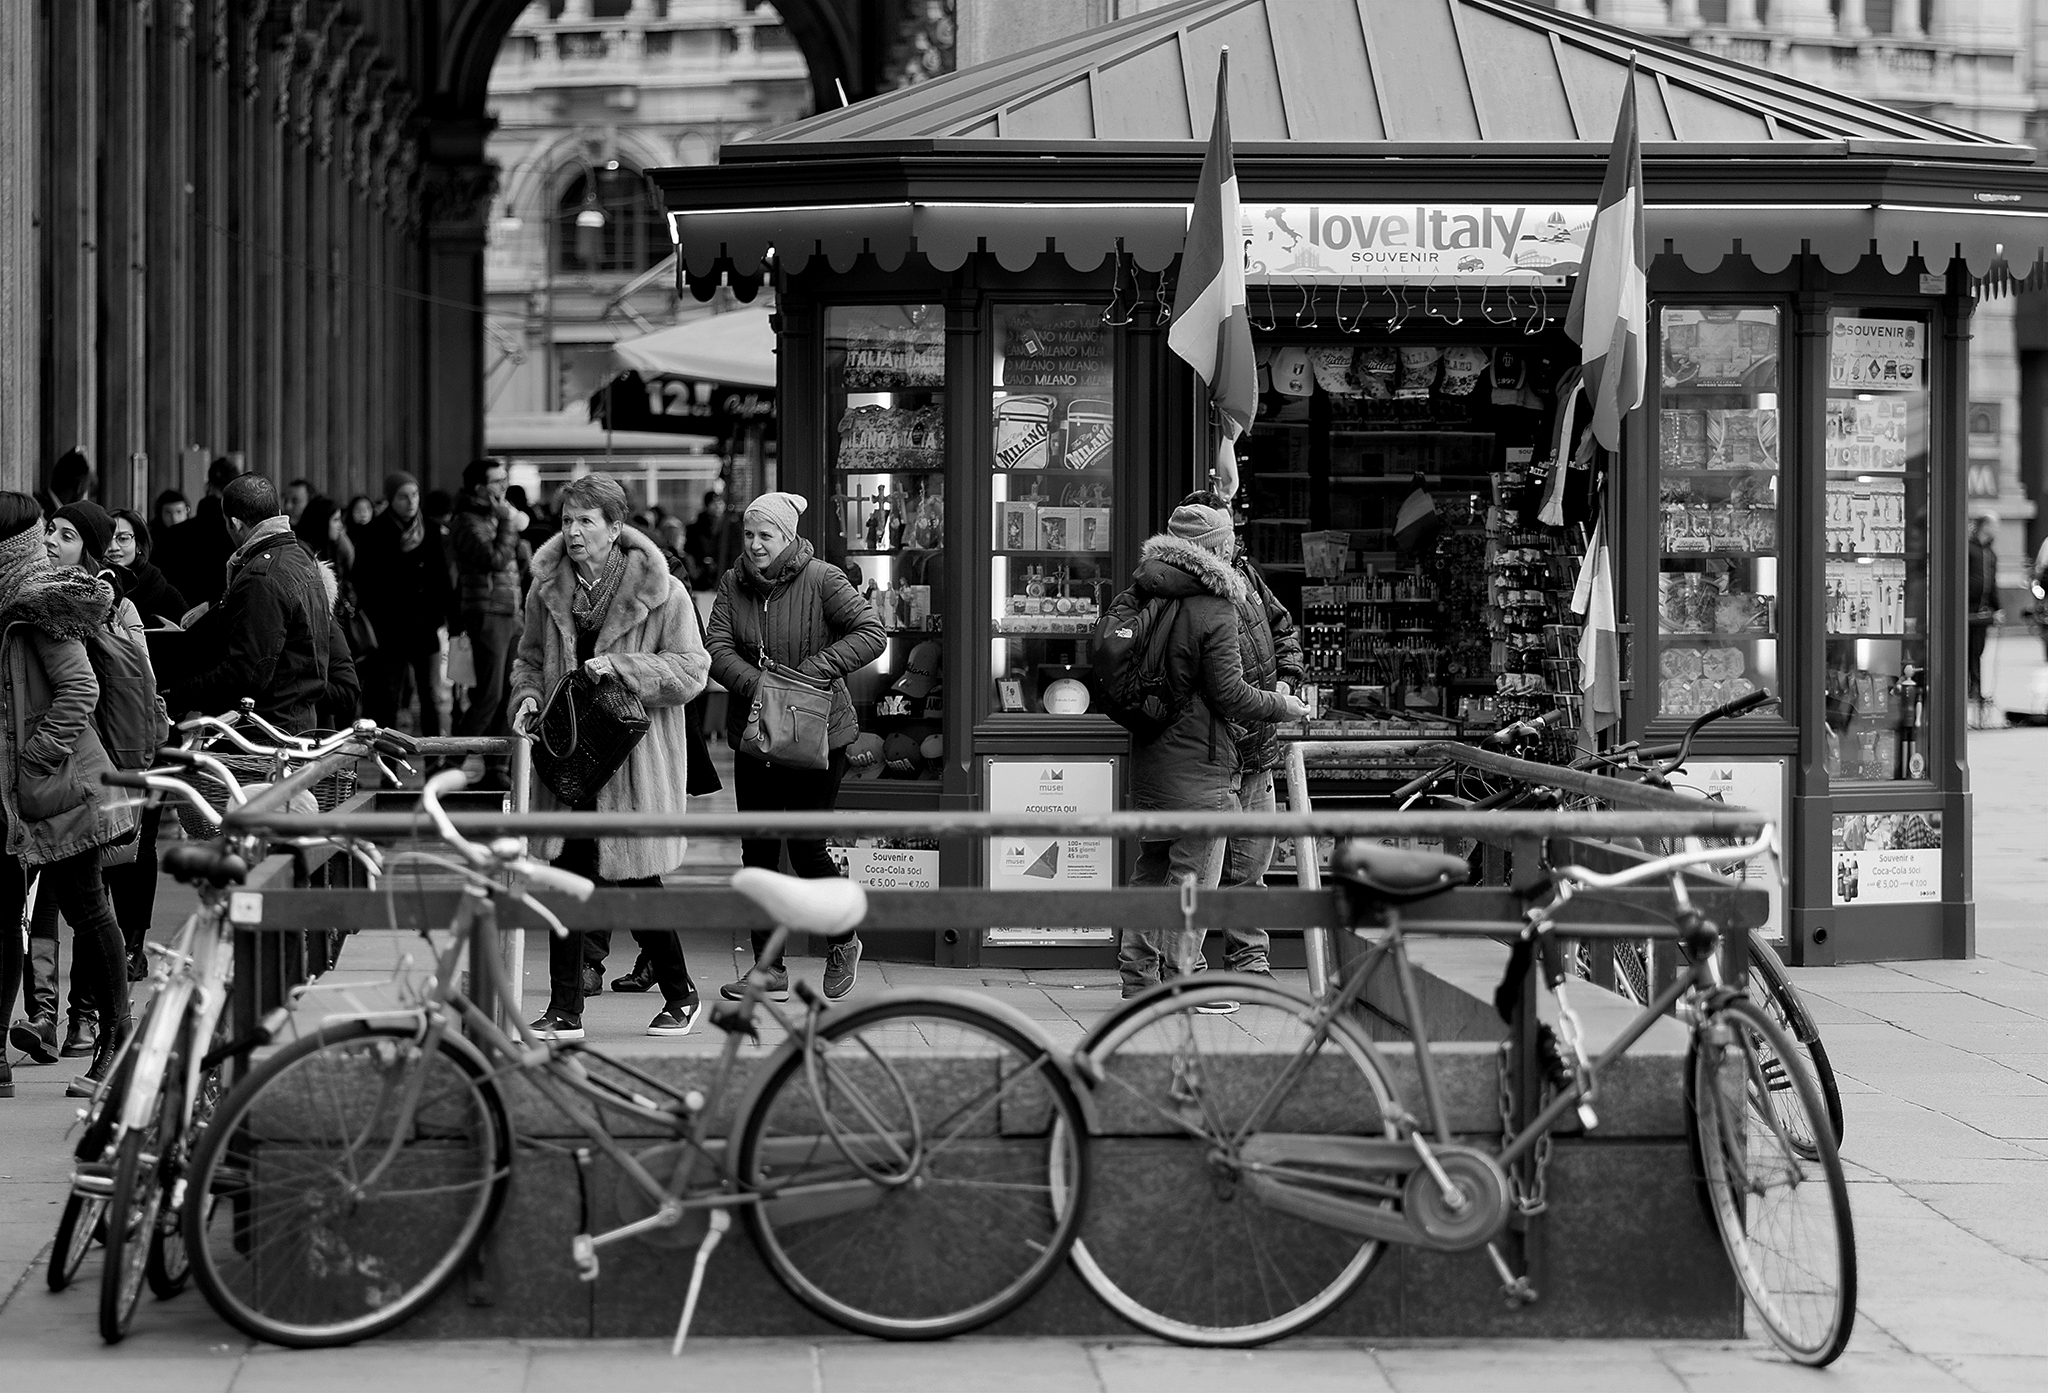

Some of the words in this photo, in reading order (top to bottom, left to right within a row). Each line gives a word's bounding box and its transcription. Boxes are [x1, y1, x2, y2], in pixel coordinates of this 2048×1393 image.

[1351, 251, 1439, 264] SOUVENIR
[1350, 265, 1440, 274] ITALIA
[1059, 331, 1098, 342] MILANO
[1847, 325, 1904, 337] SOUVENIR
[1845, 338, 1903, 348] ITALIA
[846, 350, 893, 366] ITALIA
[1015, 360, 1056, 371] MILANO
[1059, 360, 1099, 371] MILANO
[1035, 374, 1077, 385] MILANO
[996, 421, 1047, 469] MILANO
[1066, 421, 1113, 469] MILANO
[877, 695, 911, 717] NYC
[1025, 805, 1063, 813] ACQUISTA
[1063, 805, 1077, 813] QUI
[873, 852, 907, 862] Souvenir
[1879, 853, 1909, 862] Souvenir
[865, 864, 905, 874] Coca-Cola
[907, 867, 922, 875] 50cl
[1872, 866, 1907, 875] Coca-Cola
